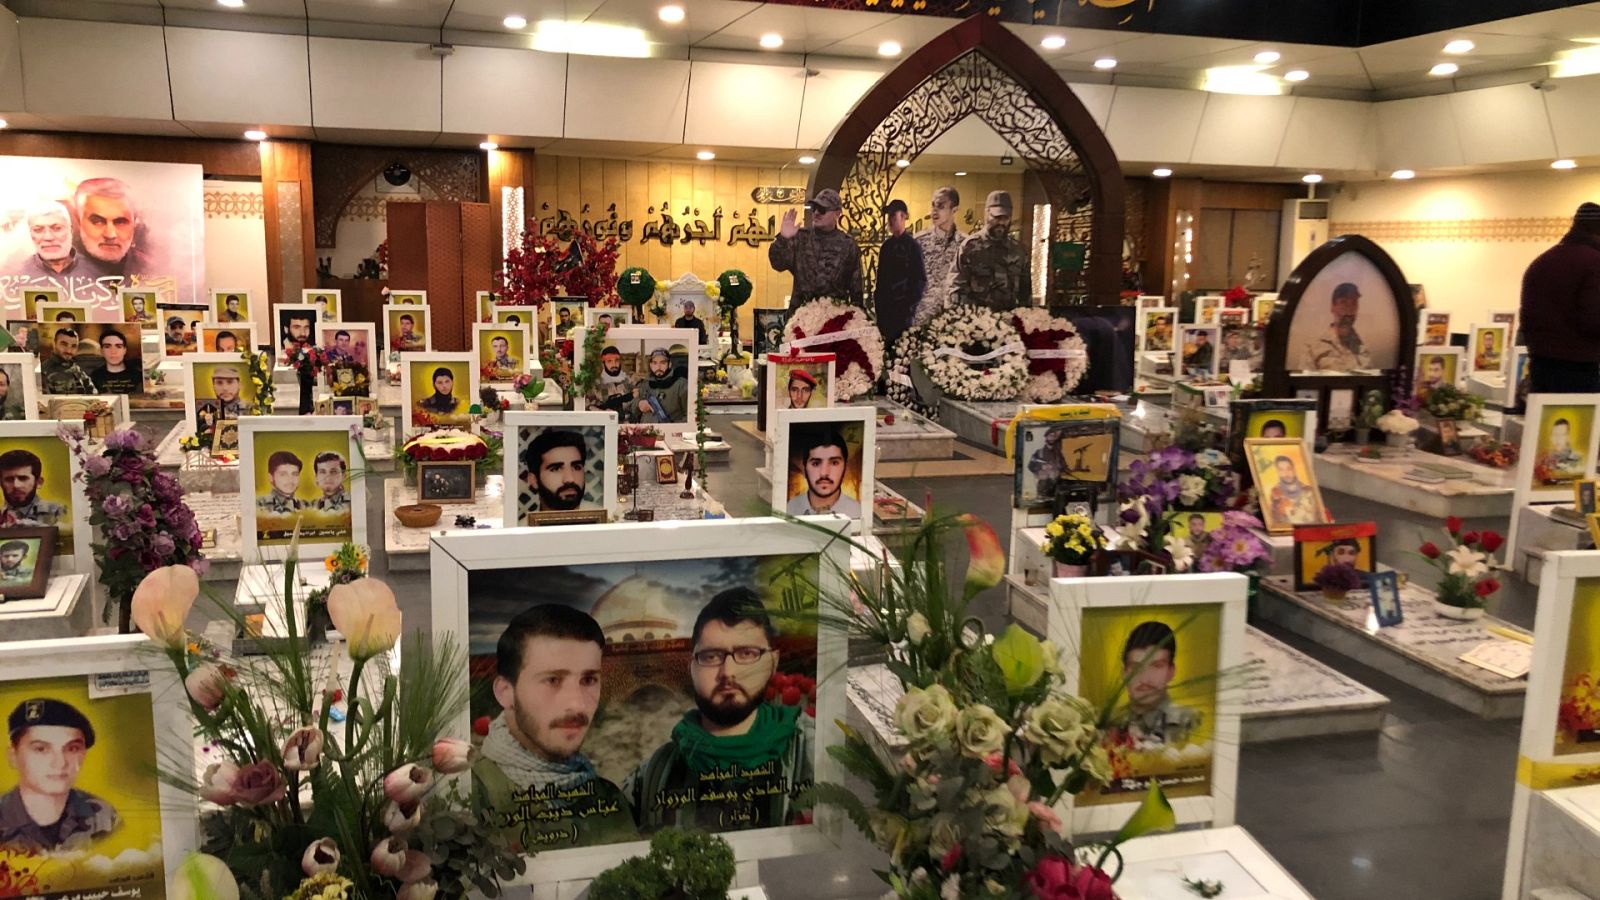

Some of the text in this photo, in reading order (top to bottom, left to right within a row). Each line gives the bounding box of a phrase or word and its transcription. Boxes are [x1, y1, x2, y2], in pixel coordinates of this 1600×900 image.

[699, 761, 775, 782] الشهيد المجاهد
[512, 781, 595, 802] الشهيد المجاهد
